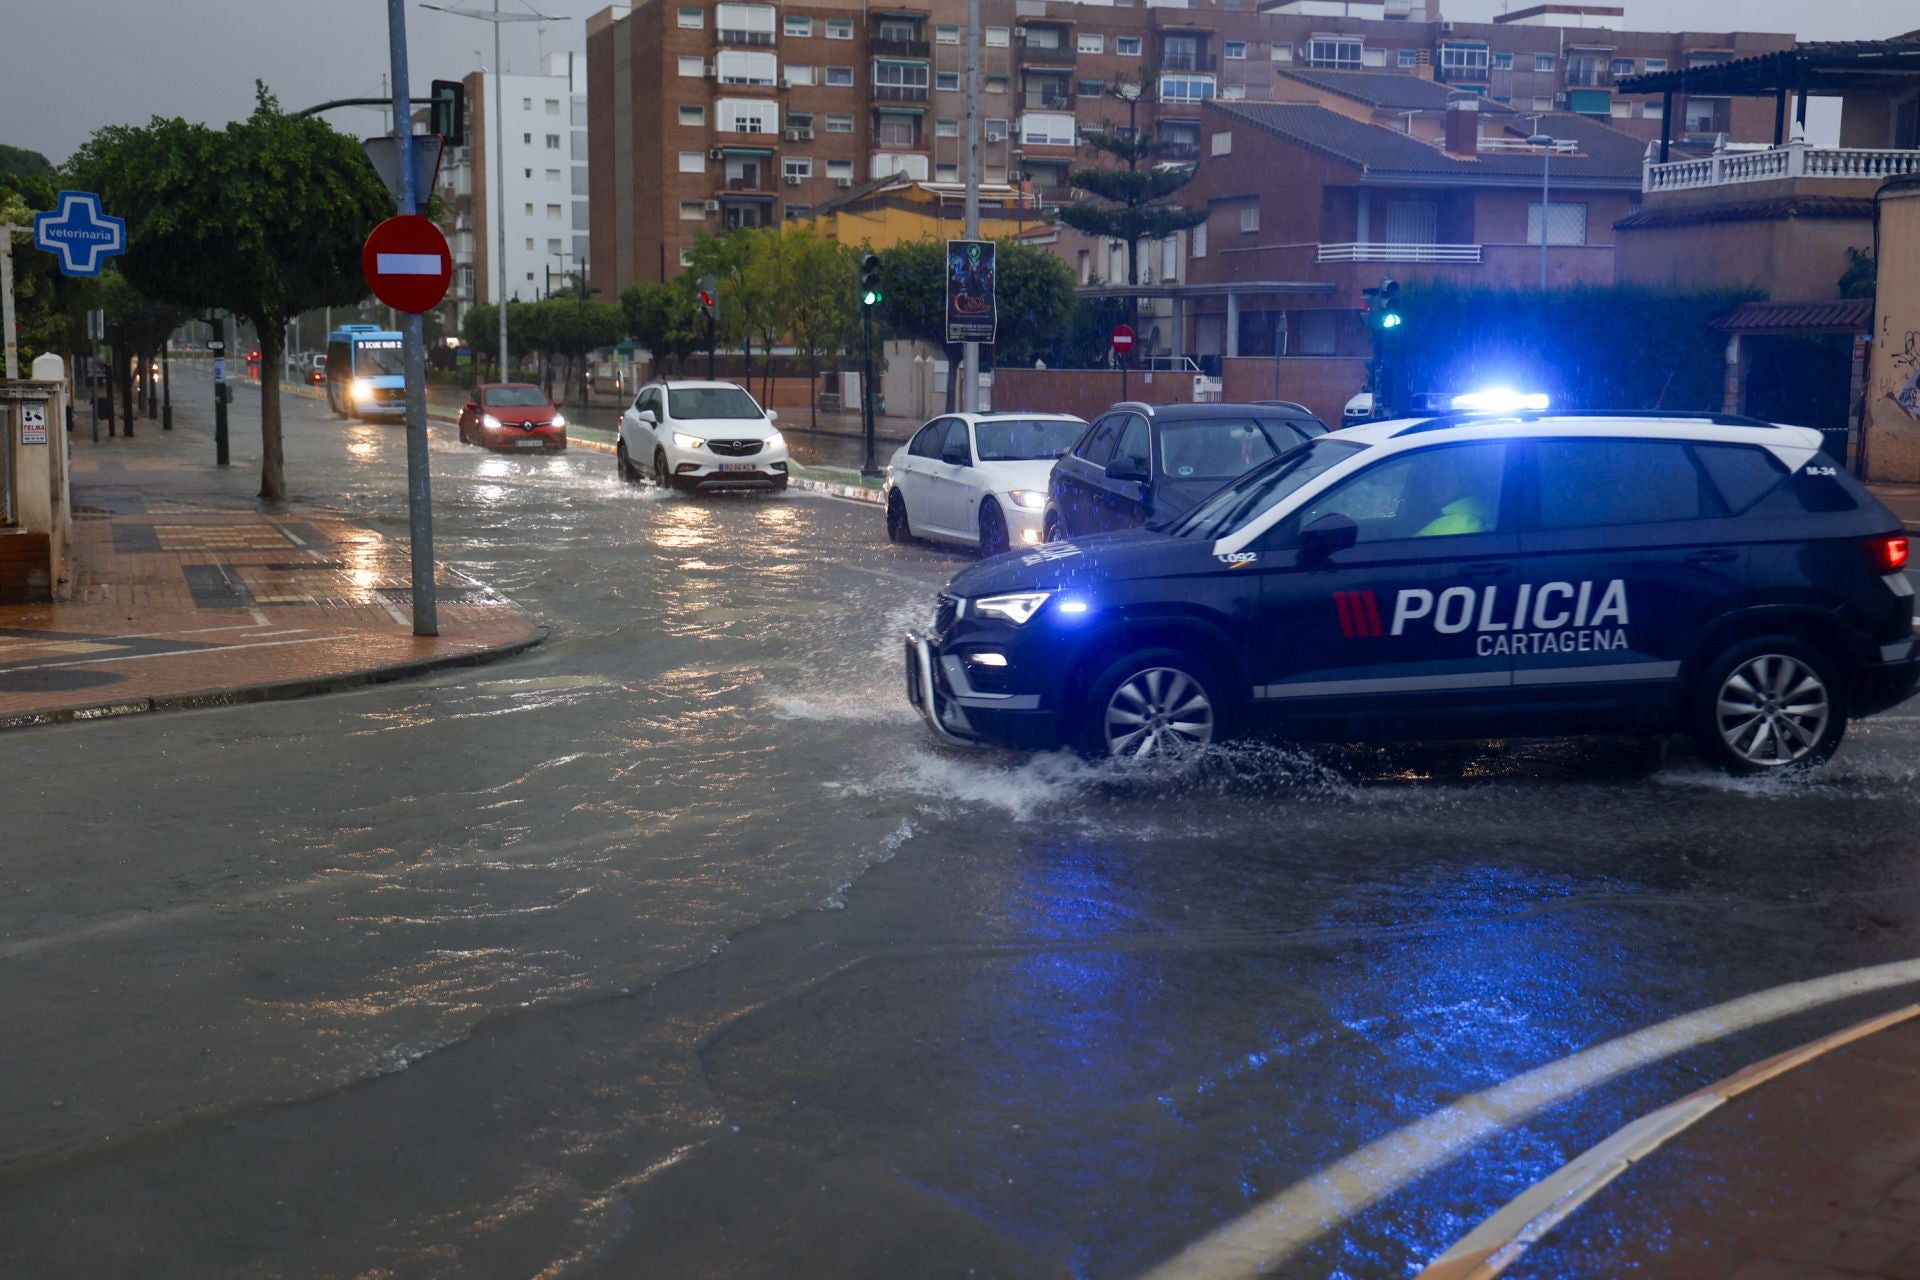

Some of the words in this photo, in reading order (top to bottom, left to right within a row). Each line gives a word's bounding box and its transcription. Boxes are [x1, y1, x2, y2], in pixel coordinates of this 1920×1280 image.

[49, 228, 112, 240] veterinaria
[1390, 579, 1629, 636] POLICIA
[1476, 629, 1629, 656] CARTAGENA
